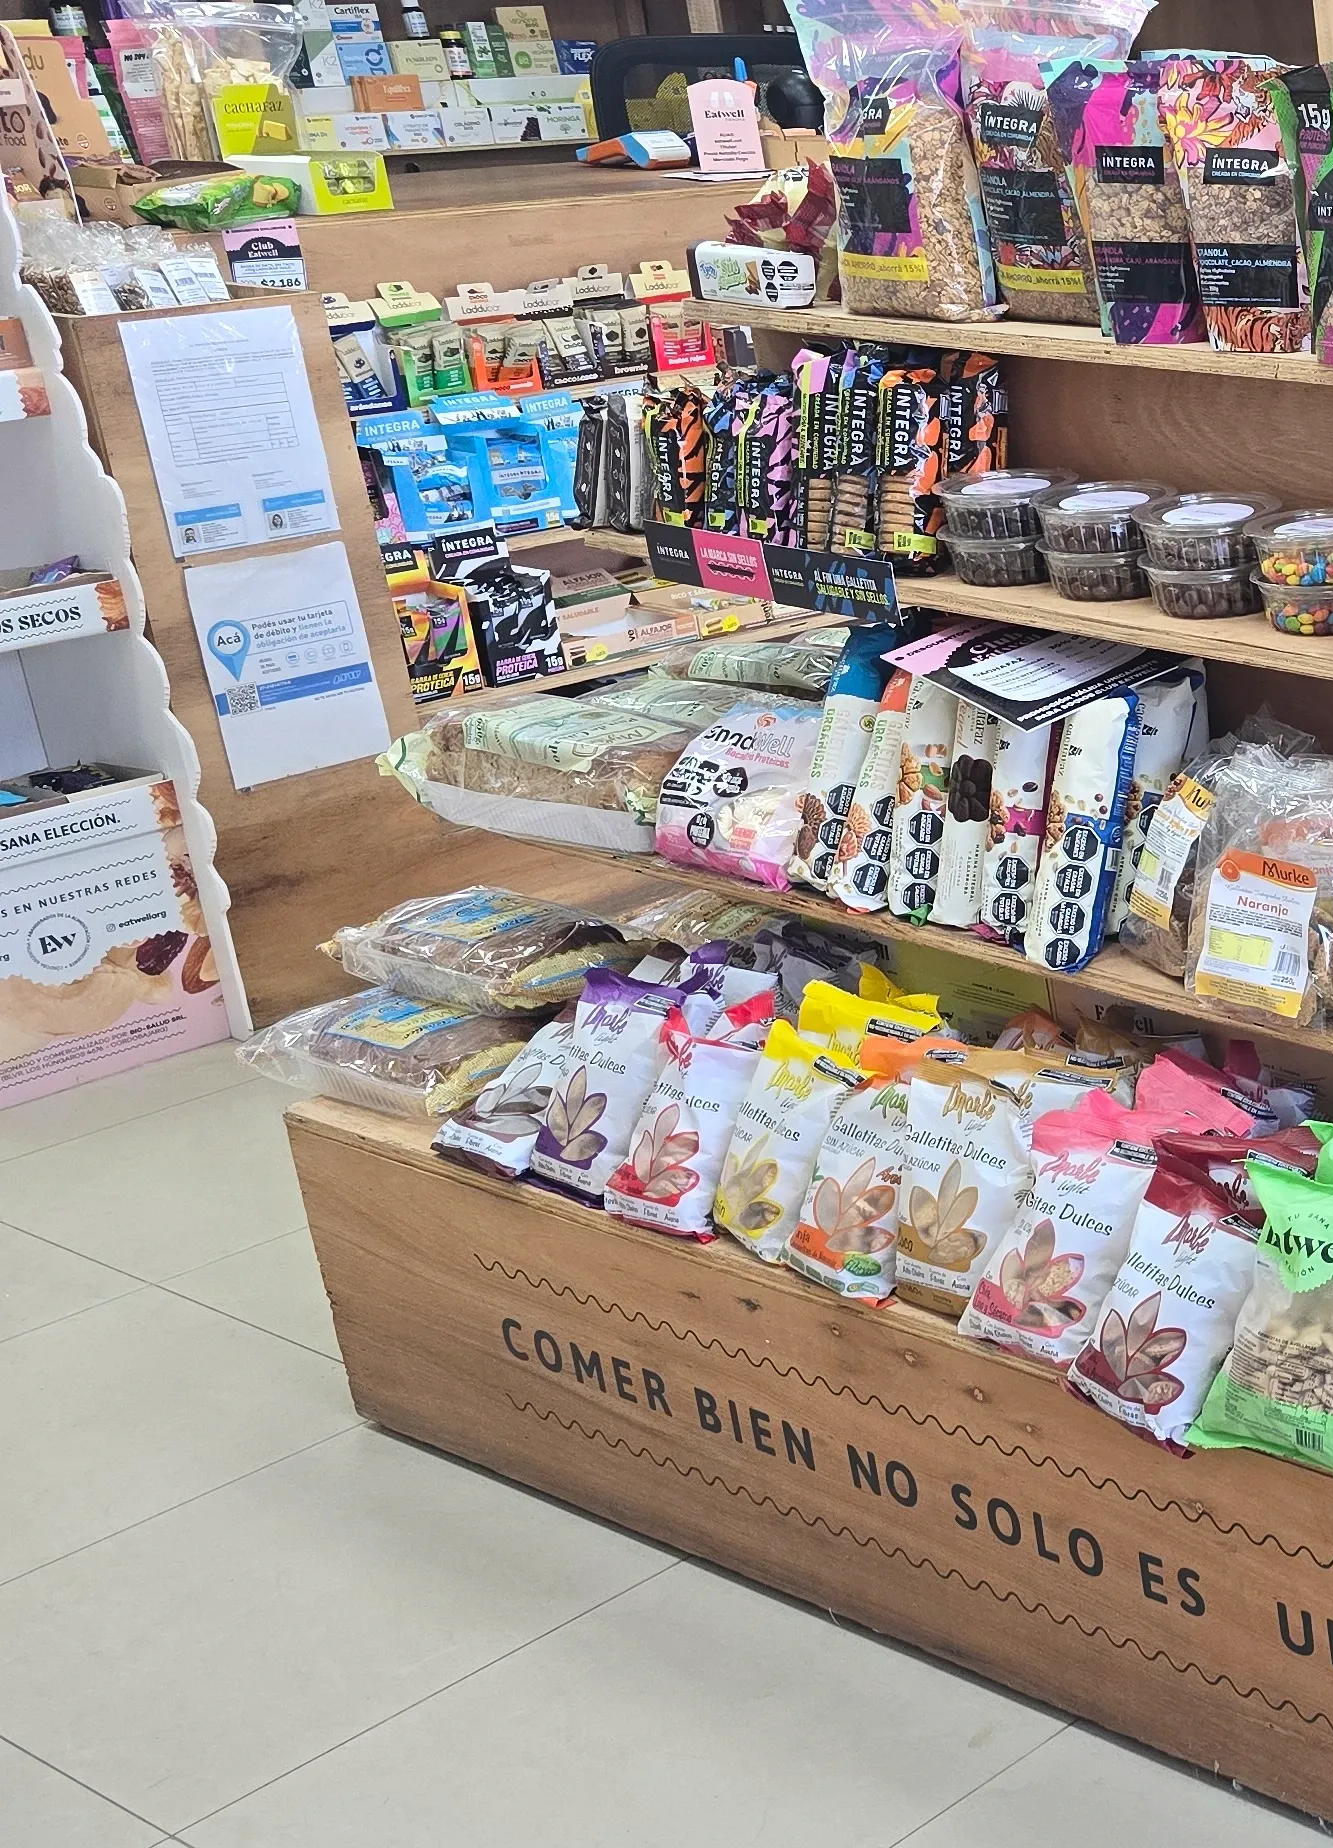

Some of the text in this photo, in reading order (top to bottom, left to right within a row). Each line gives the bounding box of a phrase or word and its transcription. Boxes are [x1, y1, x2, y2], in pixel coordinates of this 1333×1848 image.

[334, 6, 370, 15] Cartiflex
[547, 115, 581, 124] MORINGA
[704, 110, 745, 119] Eatwell
[984, 112, 1038, 134] ÍNTEGRA
[1299, 102, 1332, 131] 15g
[1102, 152, 1156, 169] ÍNTEGRA
[1212, 154, 1270, 172] ÍNTEGRA
[247, 249, 279, 258] Eatwell
[251, 241, 274, 251] Club
[614, 363, 649, 374] brownie
[441, 534, 494, 552] ÍNTEGRA
[18, 605, 82, 632] SECOS
[251, 608, 334, 631] Podés usar tu tarjeta
[216, 632, 242, 647] Acá
[972, 656, 1026, 678] CACHAFAZ
[0, 811, 122, 852] SANA ELECCIÓN.
[1261, 860, 1310, 886] Murke
[14, 869, 158, 916] EN NUESTRAS REDES
[1236, 895, 1290, 917] Naranja
[589, 1050, 627, 1075] Dulces
[832, 1116, 888, 1151] Galletitas
[910, 1156, 941, 1173] AZÚCAR
[964, 1141, 1007, 1170] Dulces
[1058, 1202, 1113, 1237] Dulces
[1167, 1280, 1216, 1310] Dulces
[502, 1316, 674, 1418] COMER
[694, 1386, 817, 1473] BIEN
[846, 1444, 919, 1509] NO
[952, 1482, 1106, 1579] SOLO
[1138, 1550, 1207, 1619] ES
